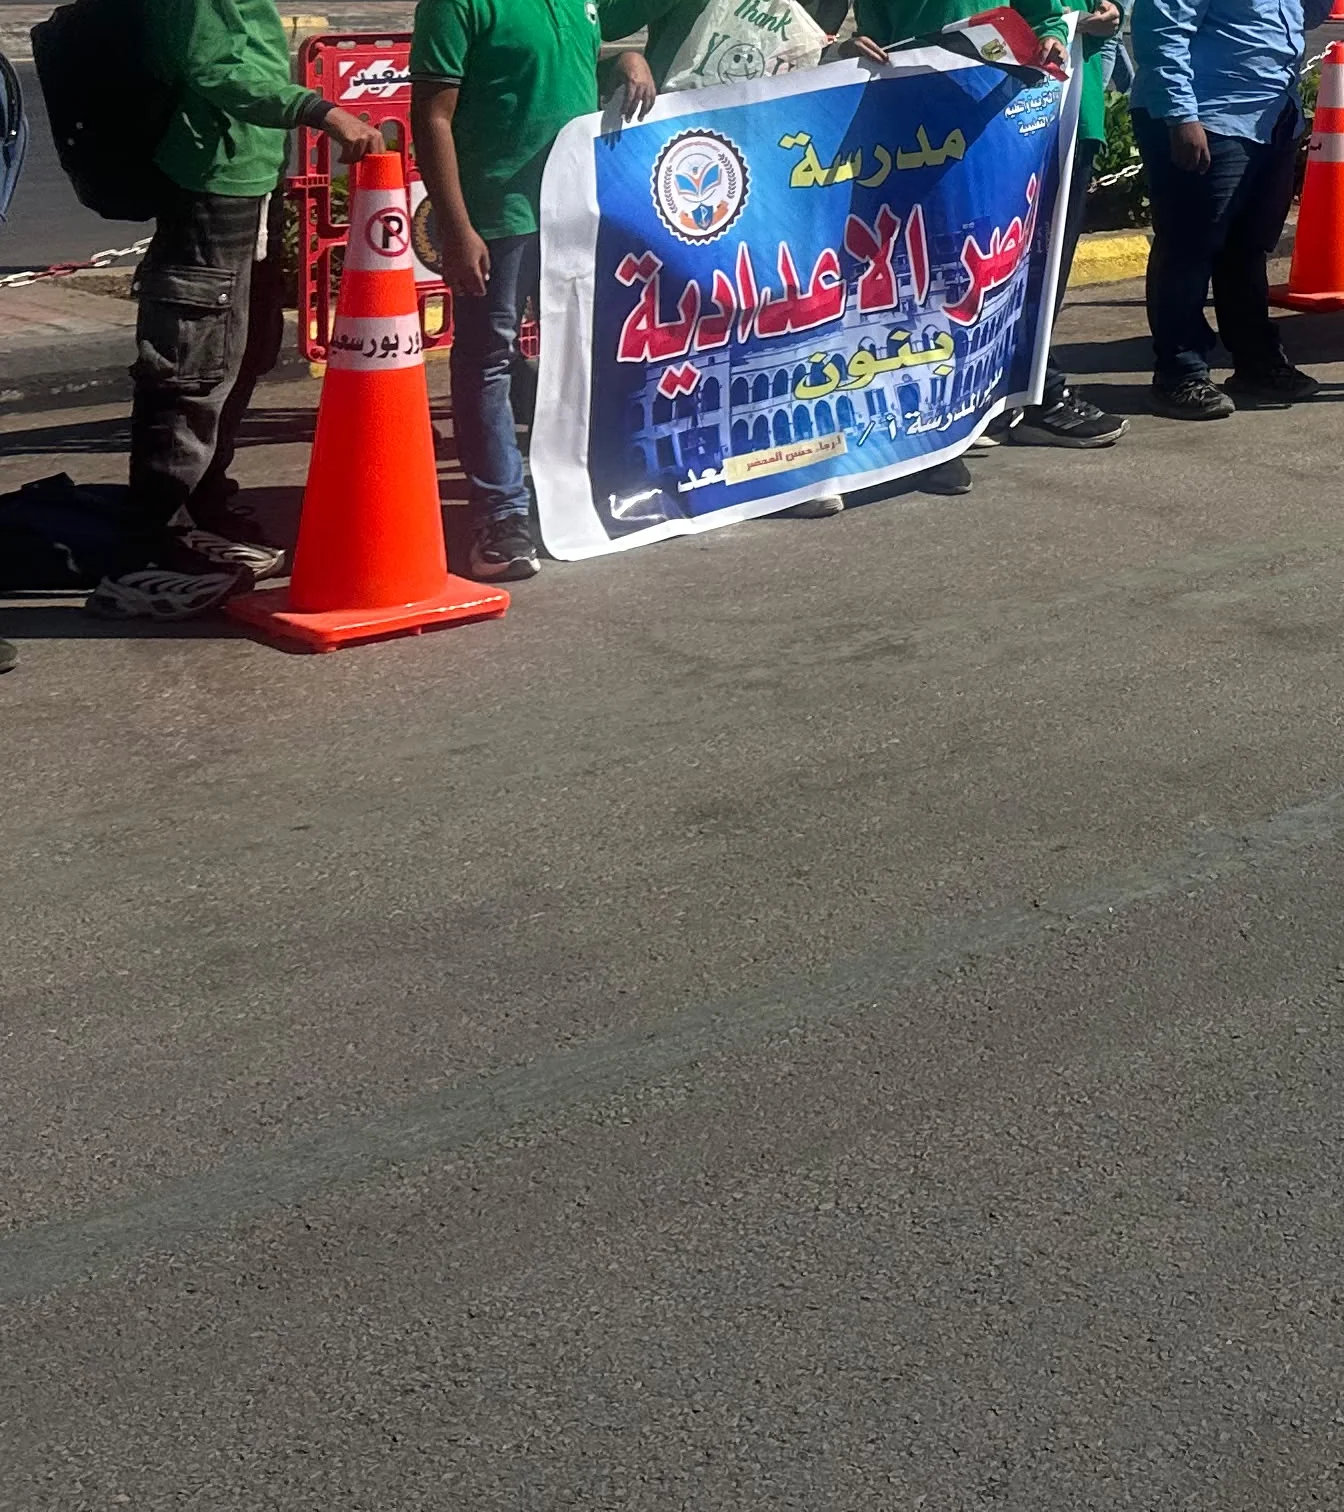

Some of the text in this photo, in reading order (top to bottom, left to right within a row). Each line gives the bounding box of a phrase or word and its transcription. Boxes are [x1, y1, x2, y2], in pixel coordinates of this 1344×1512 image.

[778, 122, 967, 189] مدرسة
[382, 216, 404, 249] P
[332, 332, 399, 358] بورسعي
[794, 326, 956, 400] بنون
[904, 390, 981, 435] المدرسة
